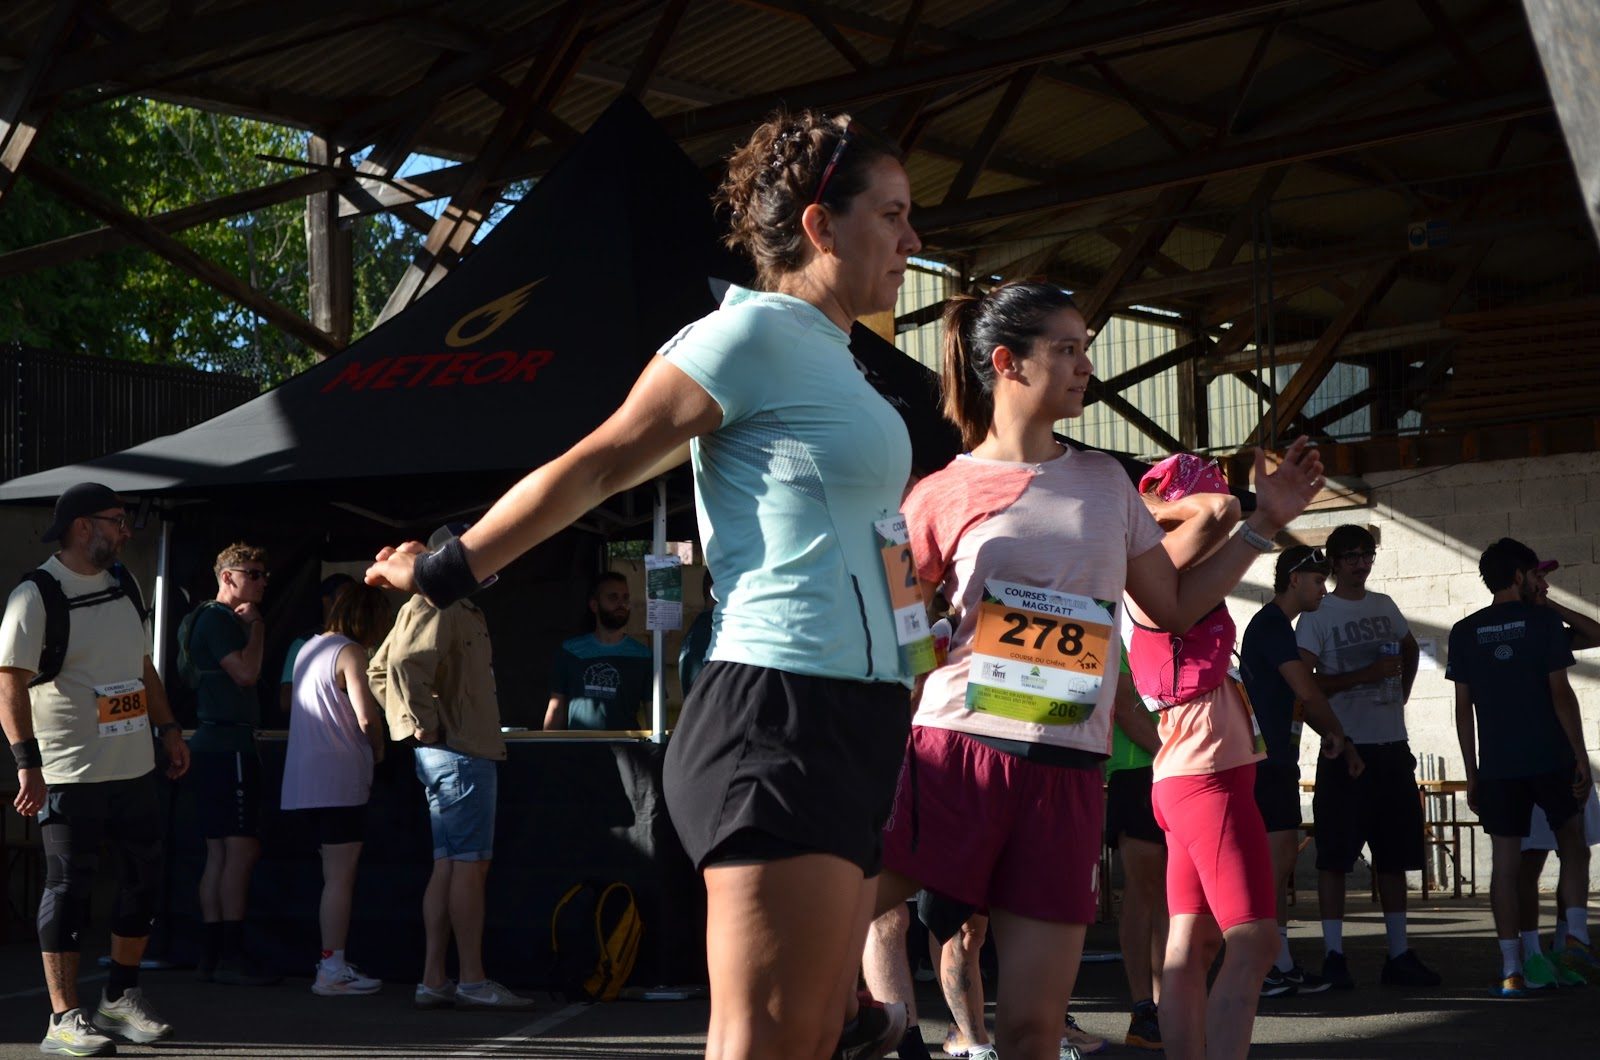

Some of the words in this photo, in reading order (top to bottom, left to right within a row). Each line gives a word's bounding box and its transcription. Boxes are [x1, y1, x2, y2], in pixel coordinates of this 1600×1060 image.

[320, 349, 556, 393] METEOR
[1004, 587, 1048, 602] COURSES
[1022, 600, 1073, 616] MAGSTATT
[998, 612, 1085, 657] 278
[1009, 652, 1034, 661] COURSE
[1080, 662, 1097, 670] 13K
[109, 693, 141, 715] 288
